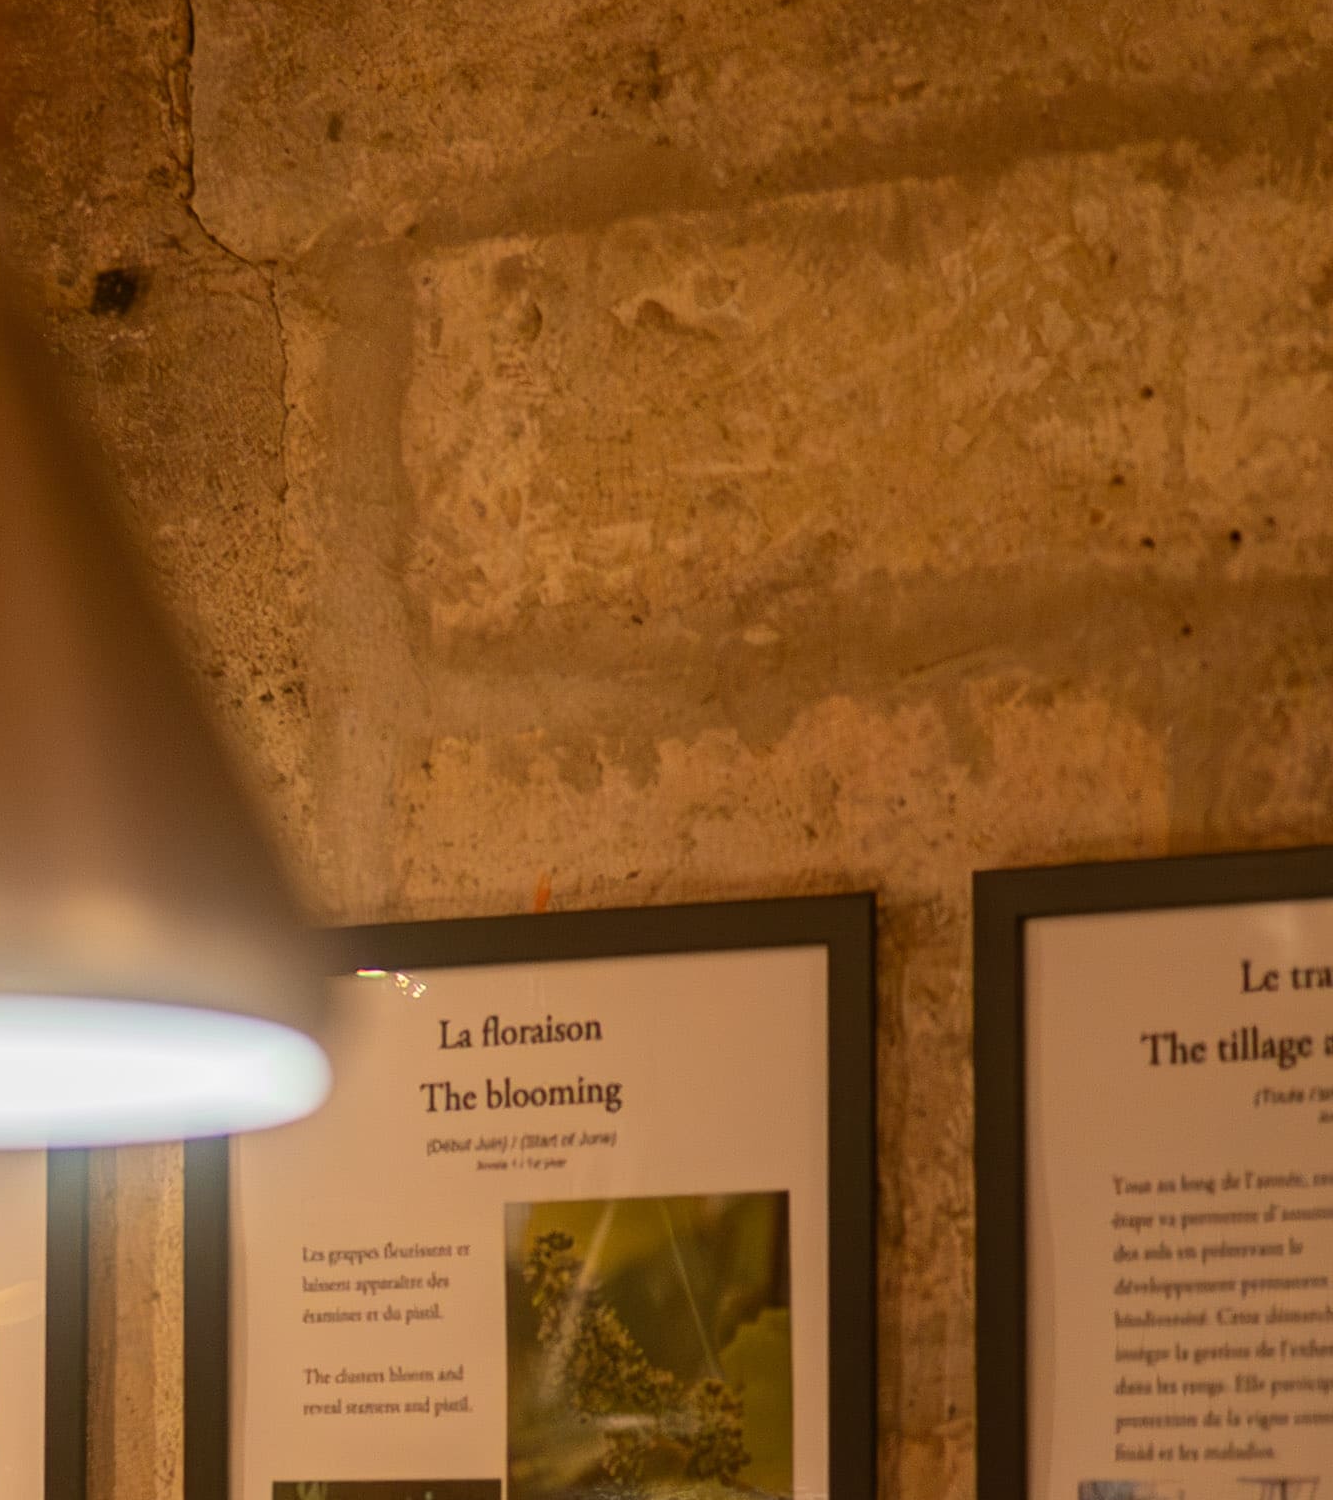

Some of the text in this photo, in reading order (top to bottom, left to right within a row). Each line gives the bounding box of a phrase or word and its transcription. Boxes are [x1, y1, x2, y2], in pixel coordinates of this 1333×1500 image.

[1241, 959, 1333, 992] Le tra
[439, 1014, 602, 1049] La floraison
[1140, 1030, 1206, 1066] The
[1217, 1025, 1312, 1070] tillage
[420, 1076, 622, 1113] The blooming
